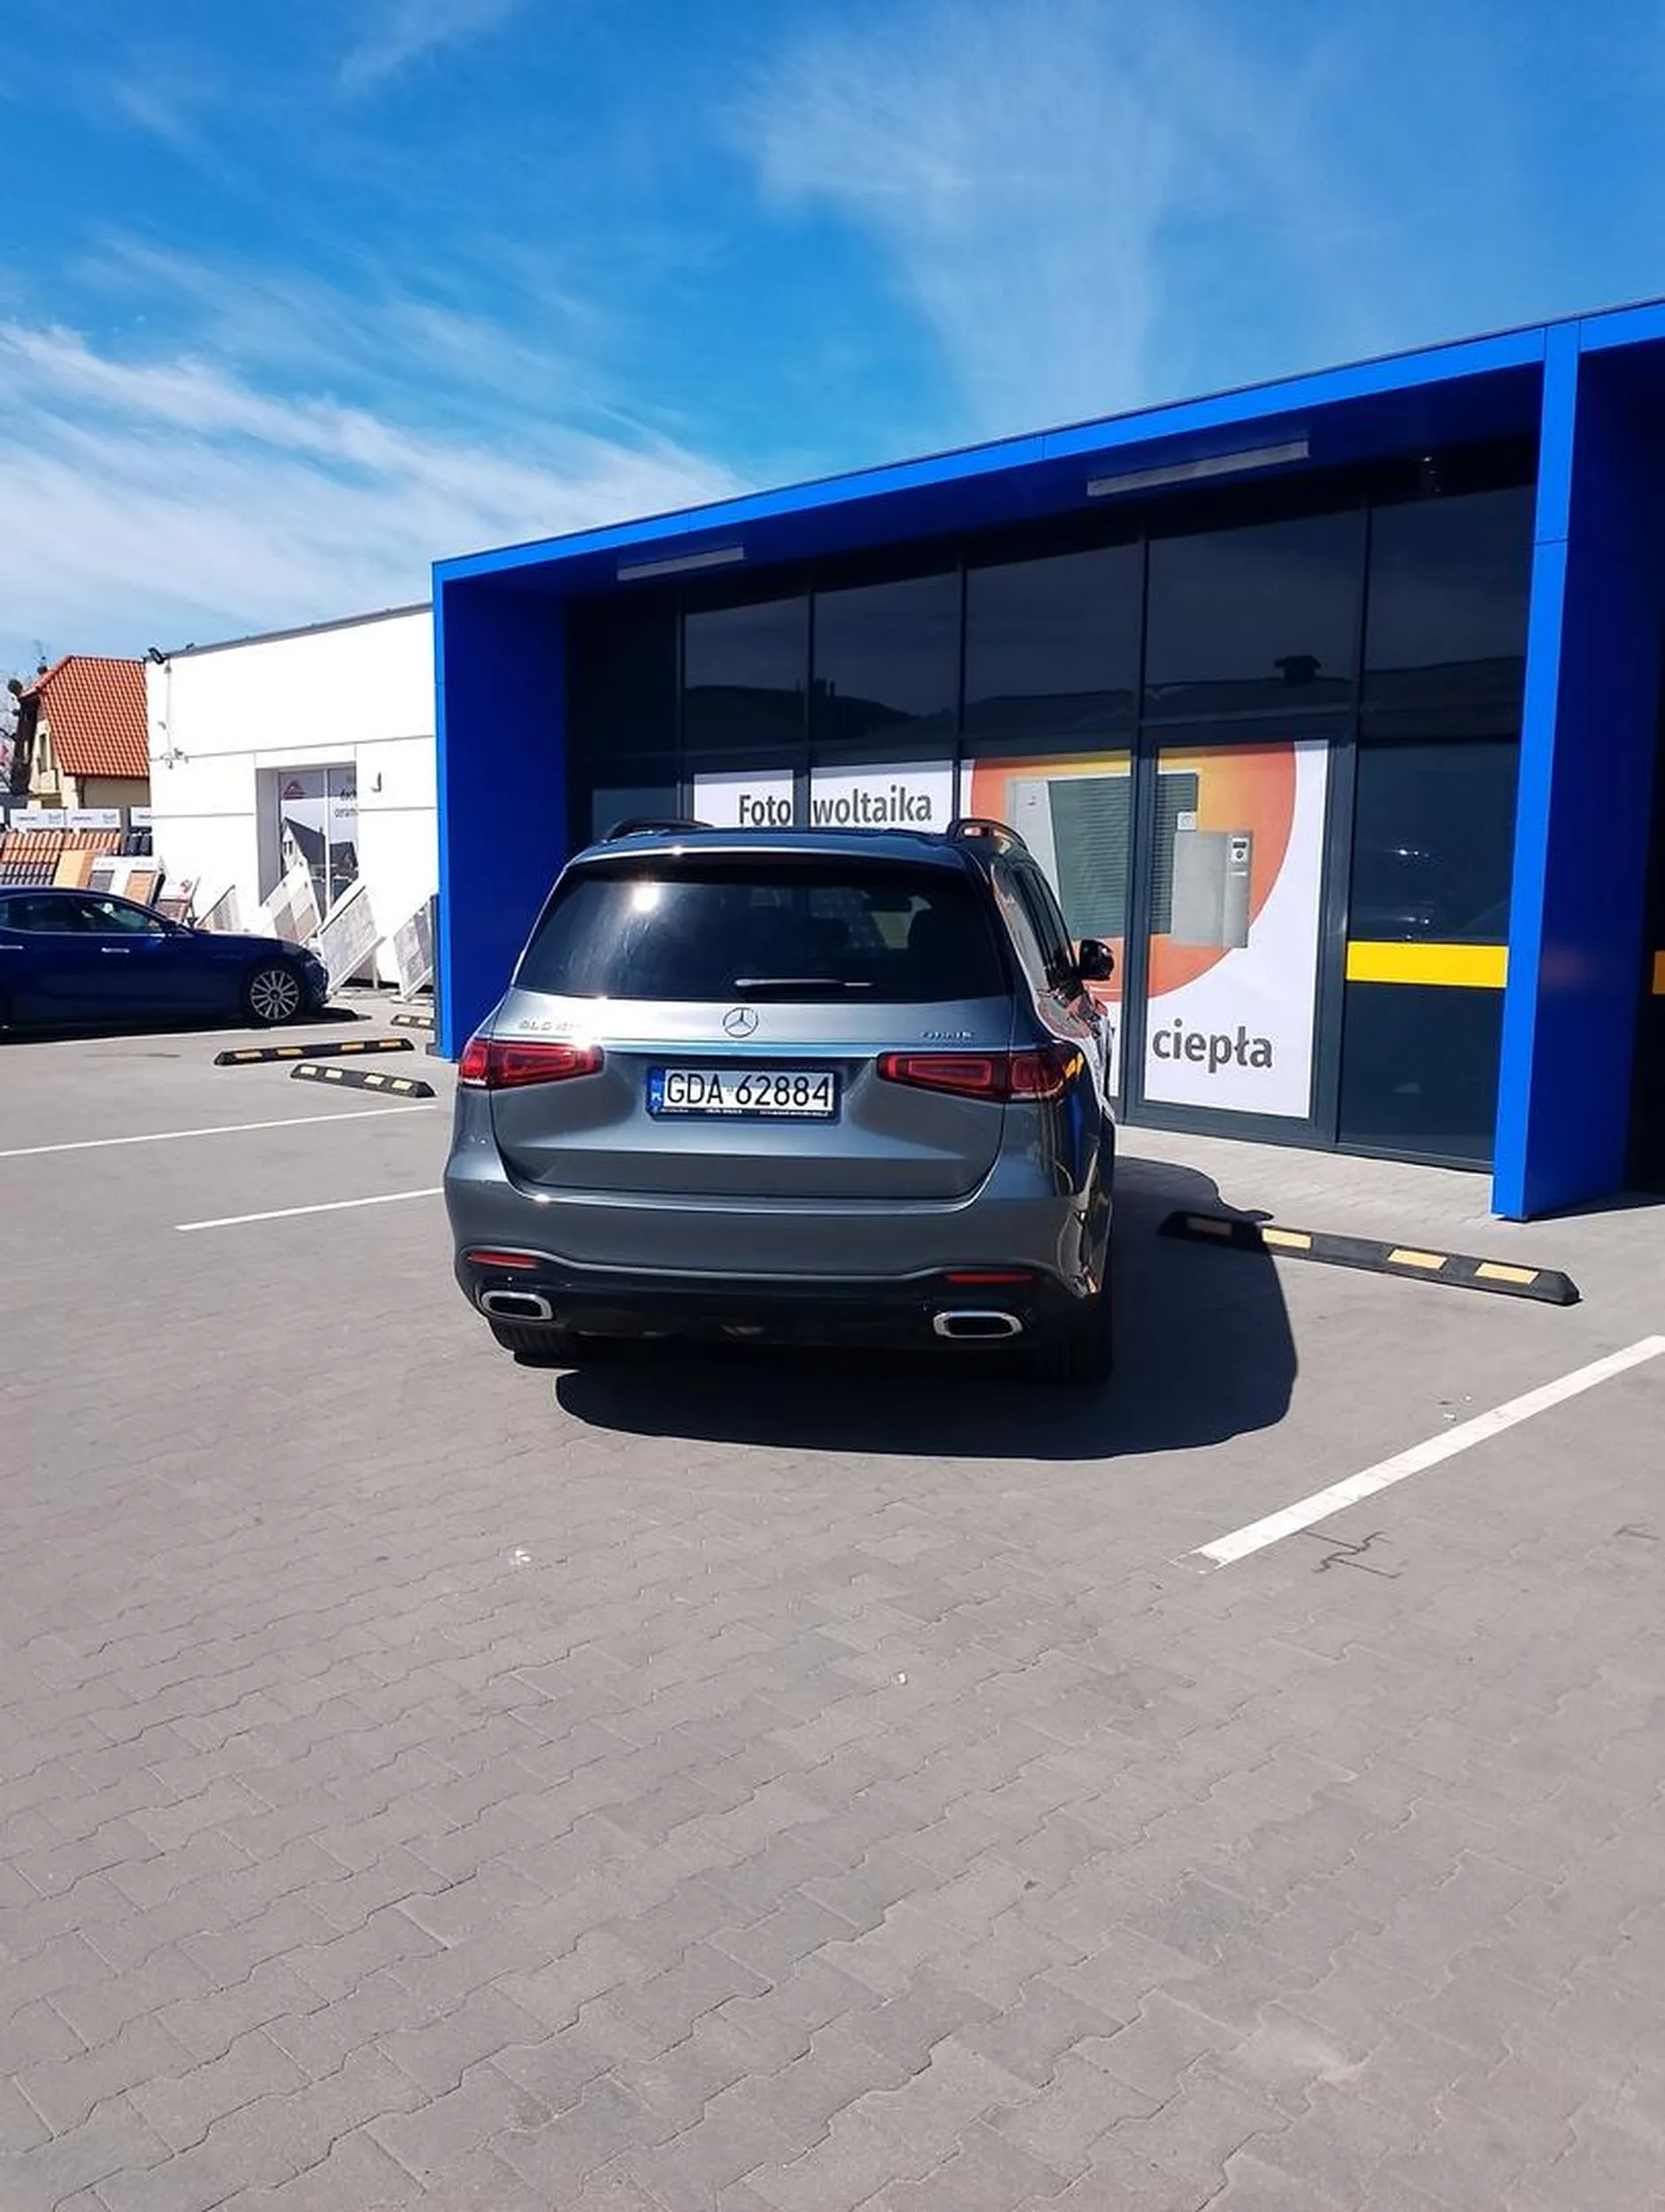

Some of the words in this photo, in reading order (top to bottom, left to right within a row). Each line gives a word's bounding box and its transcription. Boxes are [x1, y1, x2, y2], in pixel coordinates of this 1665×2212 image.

[739, 795, 792, 826] Foto
[812, 784, 932, 825] woltaika
[1152, 1018, 1273, 1073] ciepła
[666, 1072, 724, 1104] GDA
[735, 1074, 830, 1107] 62884
